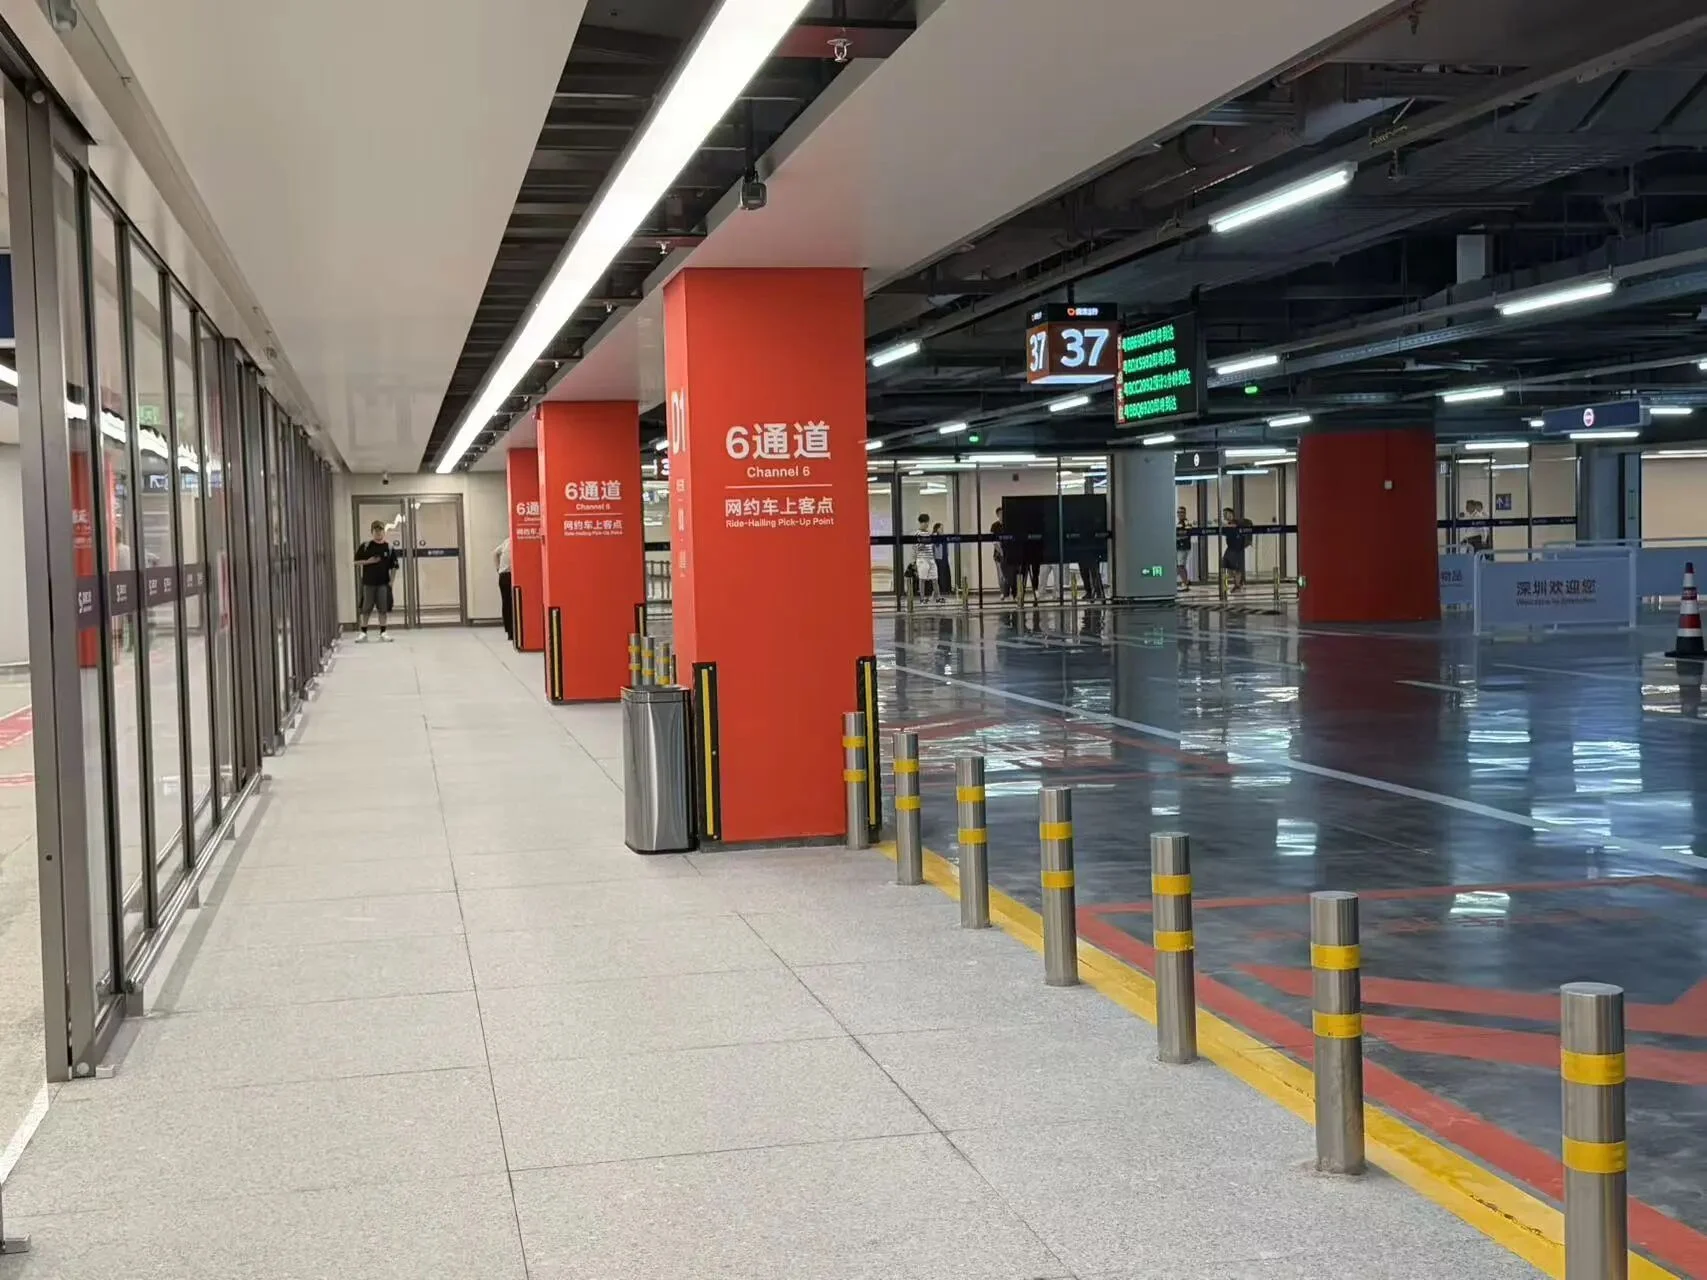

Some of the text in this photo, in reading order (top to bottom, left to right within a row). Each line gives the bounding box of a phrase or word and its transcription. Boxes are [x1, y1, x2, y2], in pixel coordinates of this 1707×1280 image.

[1029, 331, 1047, 372] 37
[1060, 328, 1110, 367] 37
[725, 420, 832, 460] 6通道
[747, 465, 811, 478] Channel 6
[565, 480, 622, 500] 6通道
[516, 501, 541, 516] 6通
[725, 496, 834, 517] 网约车上客点
[726, 516, 835, 529] Ride-Hailing Pick-Up Point
[1516, 579, 1597, 597] 深圳欢迎您
